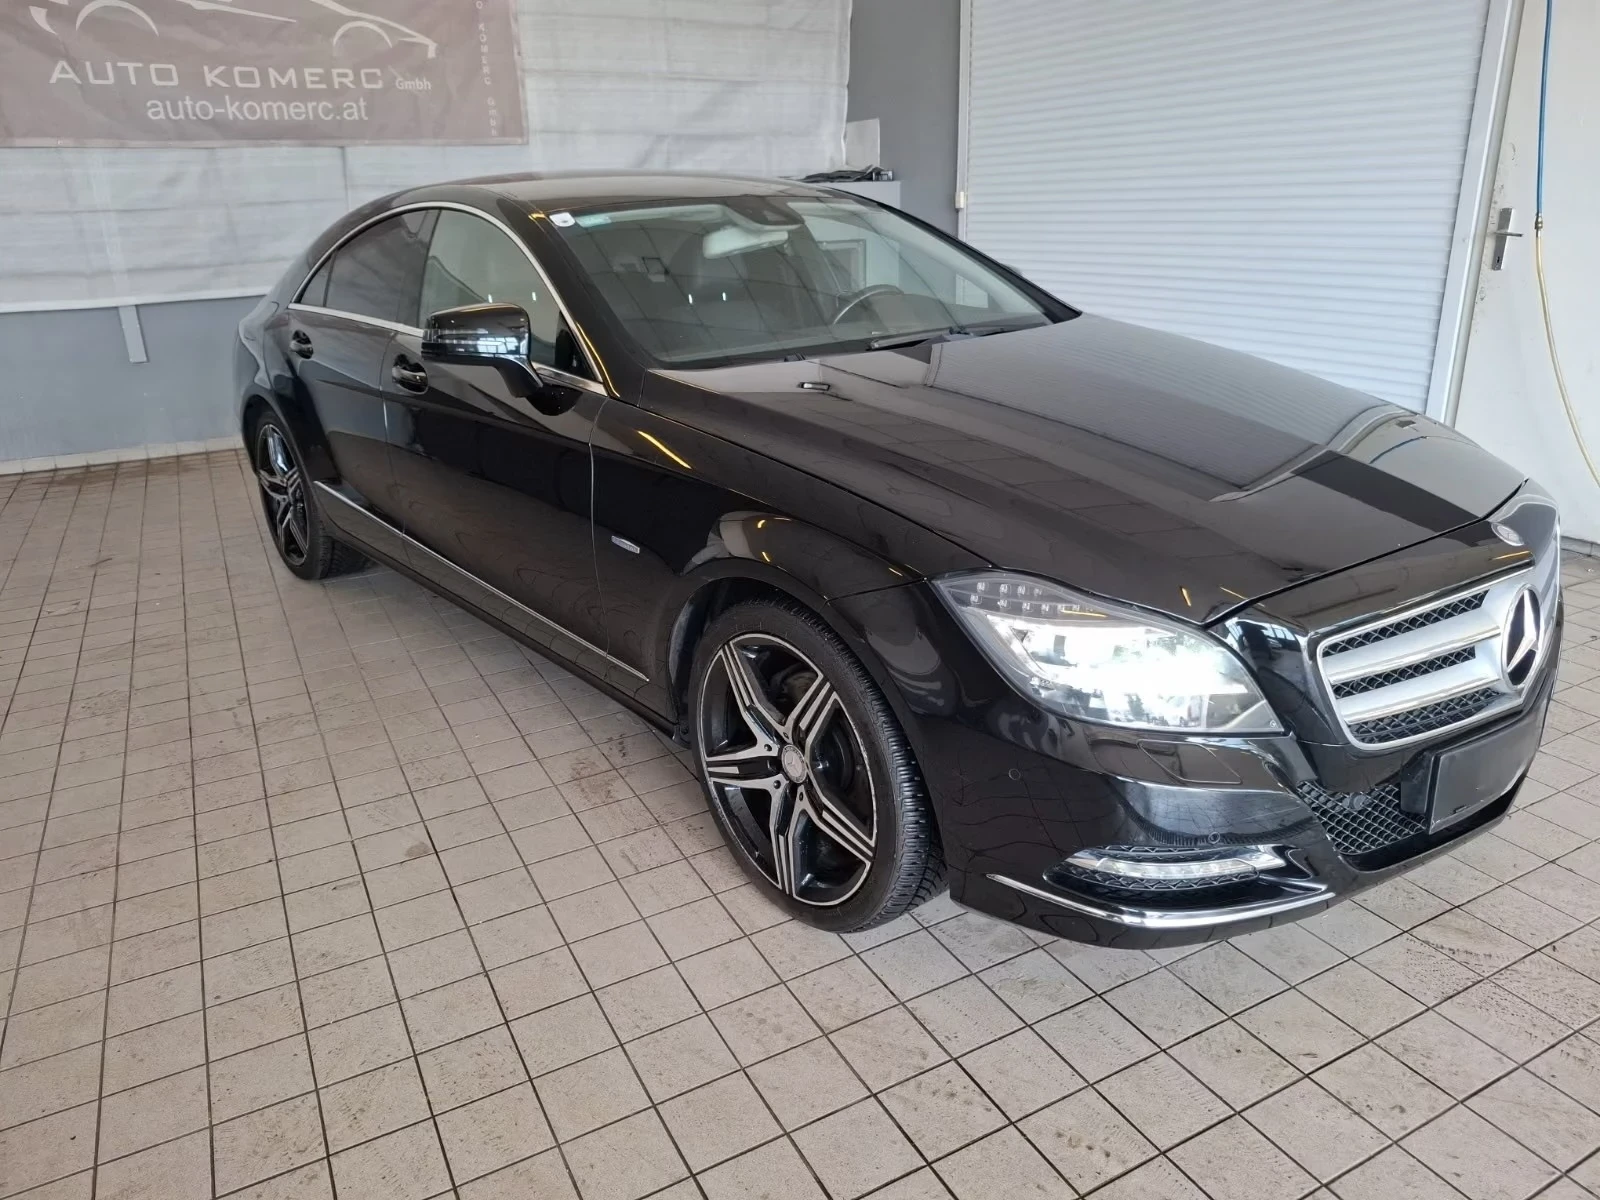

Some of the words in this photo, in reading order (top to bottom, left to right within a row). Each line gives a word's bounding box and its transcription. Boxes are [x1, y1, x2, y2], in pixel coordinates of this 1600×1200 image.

[49, 60, 179, 87] AUTO
[203, 65, 384, 89] KOMERC
[395, 77, 432, 91] Gmbh
[146, 95, 369, 121] auto-komerc.at
